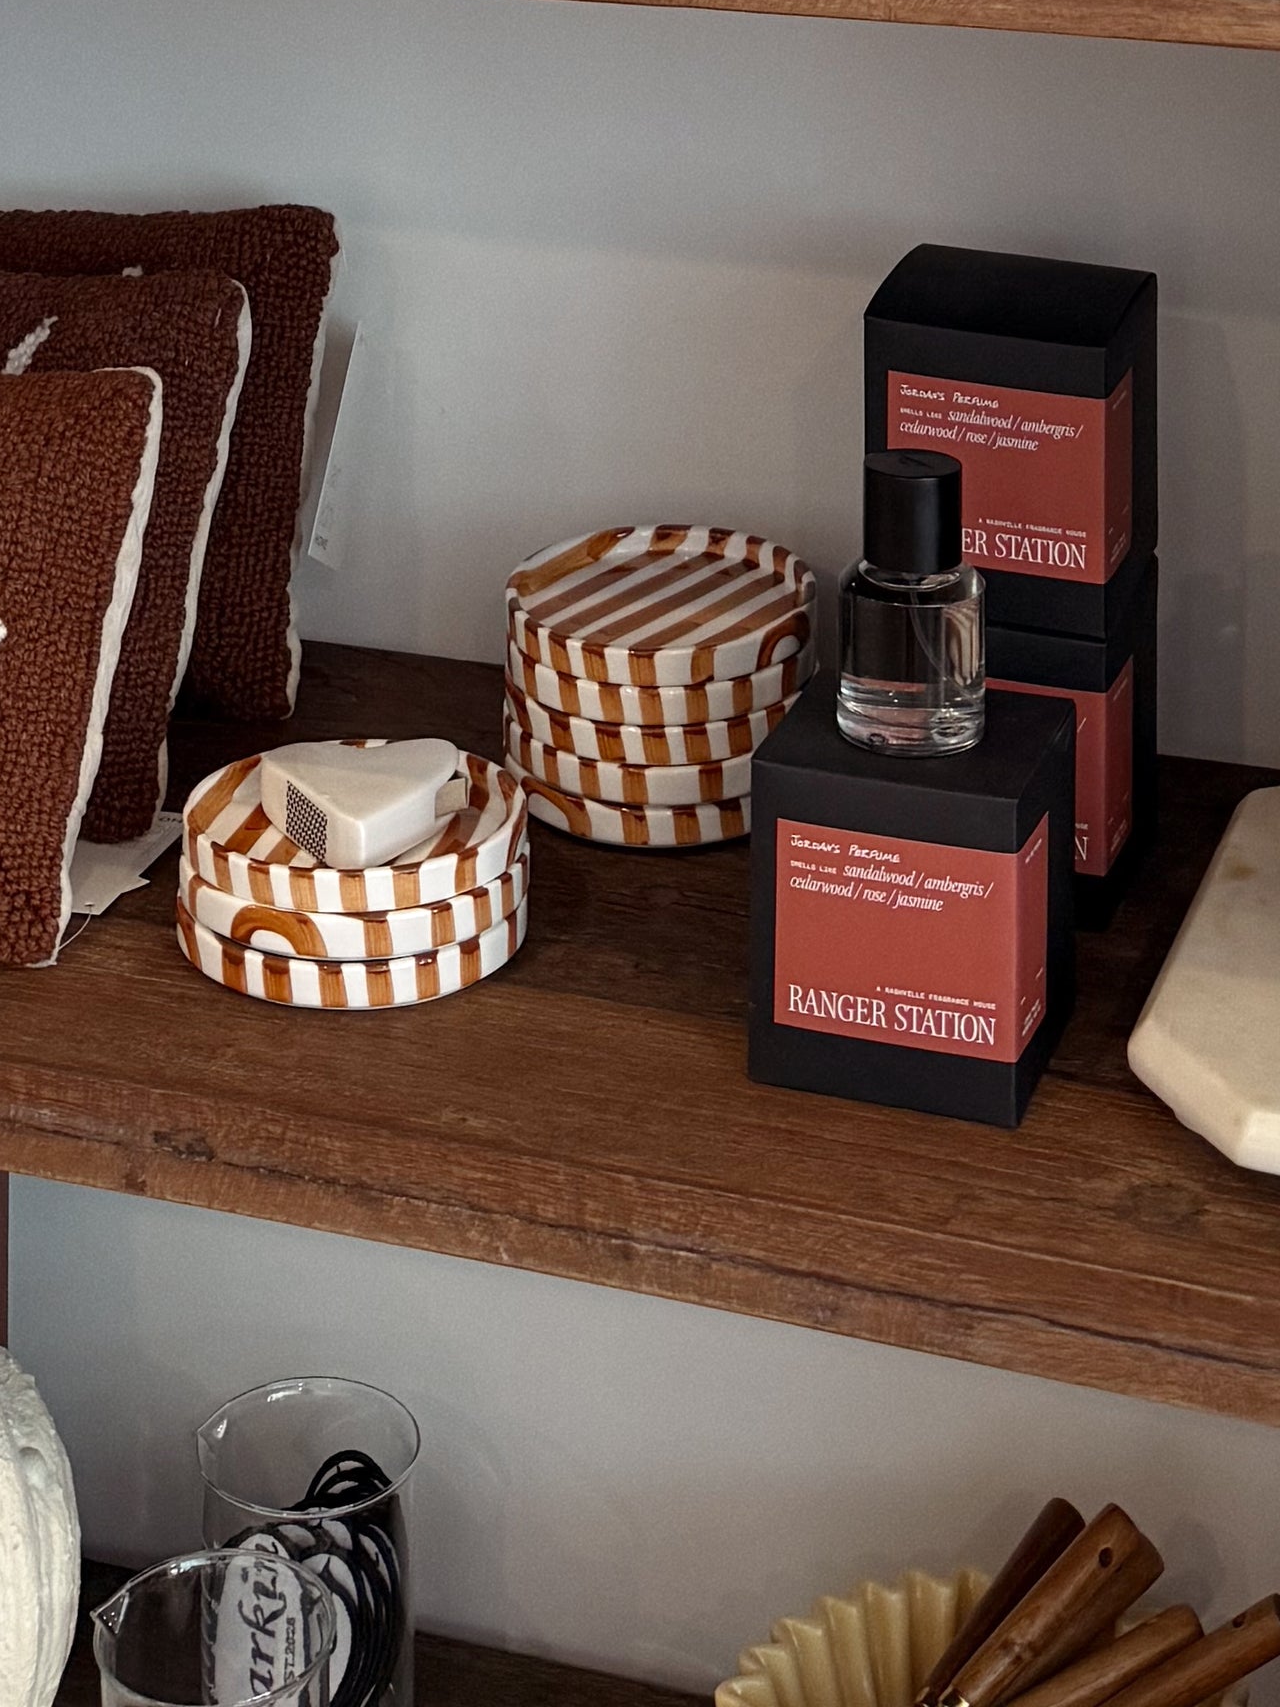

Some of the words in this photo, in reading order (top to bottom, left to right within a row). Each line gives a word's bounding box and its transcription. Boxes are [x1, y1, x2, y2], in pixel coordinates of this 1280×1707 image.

[900, 420, 956, 439] cedarwood
[965, 431, 987, 444] rose
[994, 434, 1039, 451] jasmine
[948, 409, 1013, 430] sandalwood
[1021, 418, 1076, 440] ambergris
[995, 532, 1087, 570] STATION
[848, 844, 900, 863] PERFUME
[790, 874, 853, 898] cedarwood
[863, 889, 887, 903] rose
[893, 890, 944, 912] jasmine
[843, 864, 916, 887] sandalwood
[924, 875, 985, 899] ambergris
[788, 984, 887, 1029] RANGER
[894, 1003, 997, 1046] STATION
